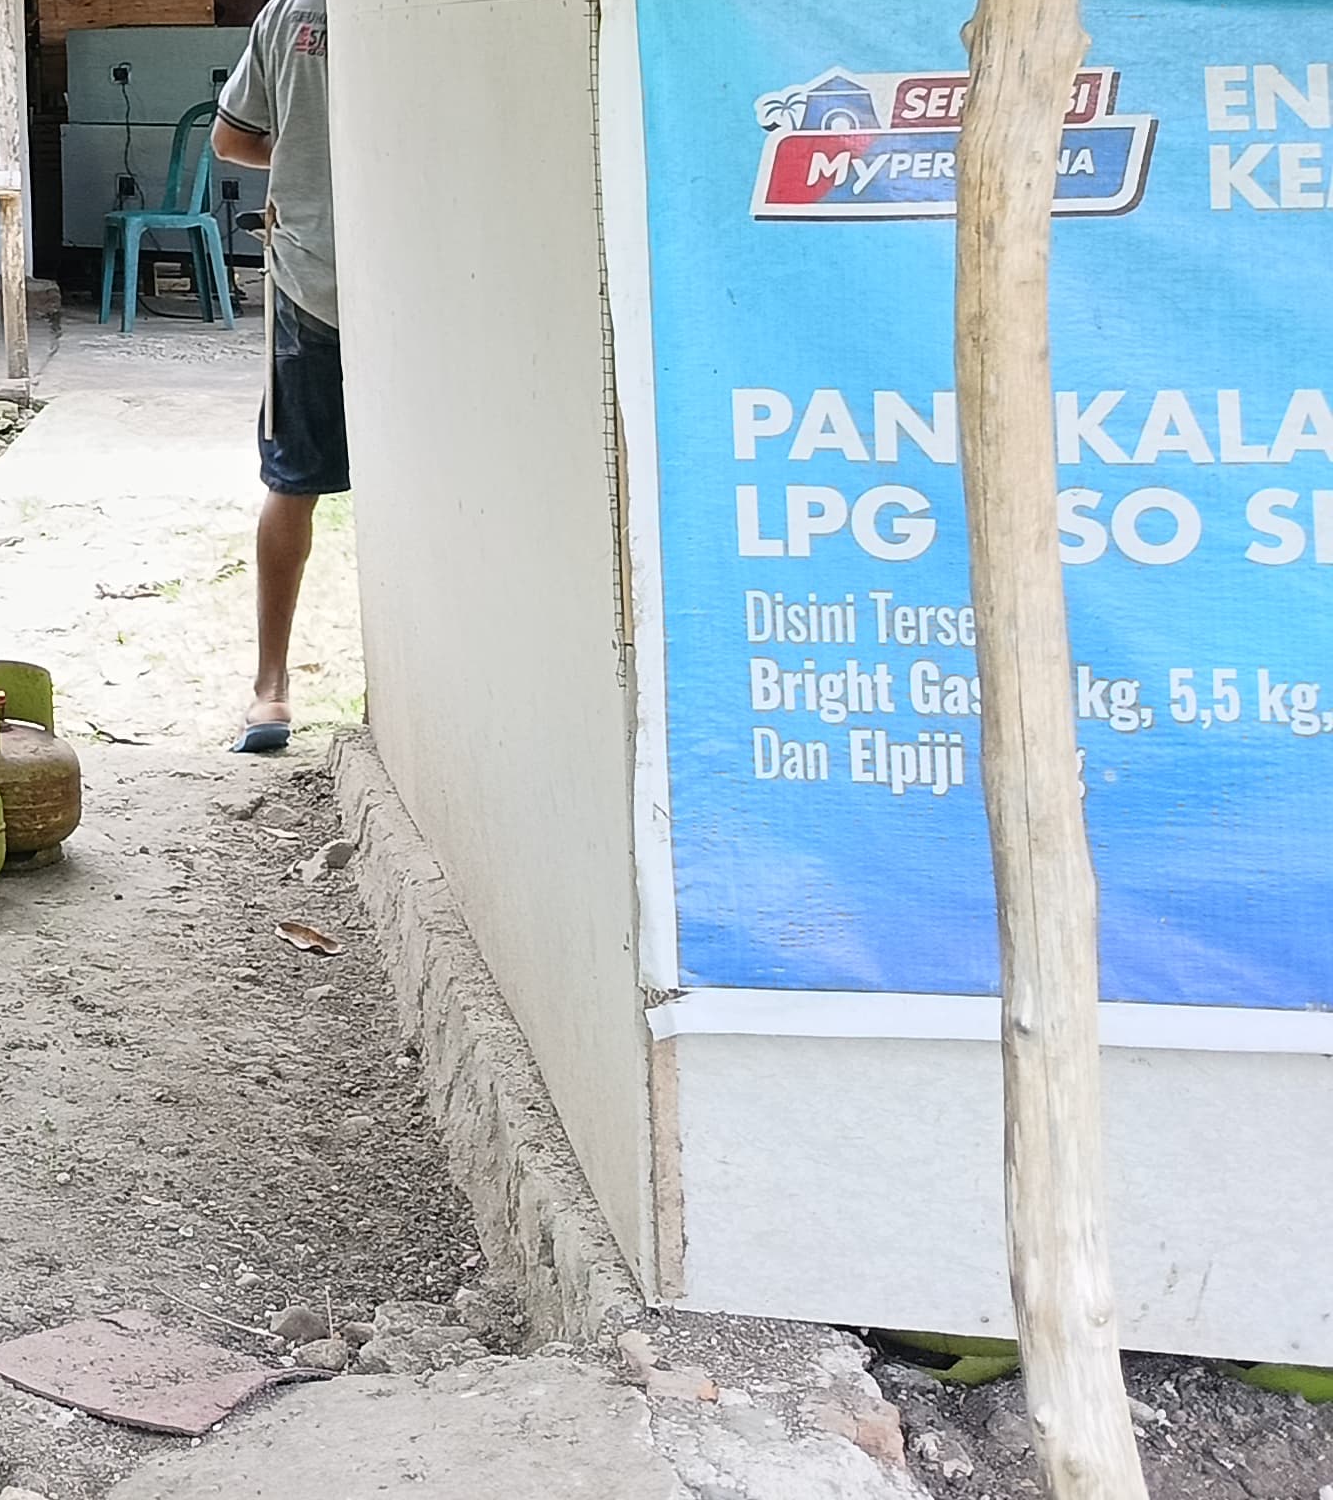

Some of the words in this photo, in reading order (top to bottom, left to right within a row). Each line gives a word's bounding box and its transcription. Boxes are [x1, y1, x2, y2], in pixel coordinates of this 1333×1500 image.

[1205, 63, 1331, 131] EN
[1209, 143, 1333, 210] KE
[733, 388, 1333, 464] PANKALA
[736, 484, 936, 561] LPG
[745, 589, 856, 644] Disini
[750, 657, 895, 723] Bright
[1077, 665, 1153, 732] kg,
[1169, 668, 1241, 730] 5,5
[1257, 668, 1333, 736] kg,
[752, 727, 829, 781] Dan
[849, 729, 964, 795] Elpiji
